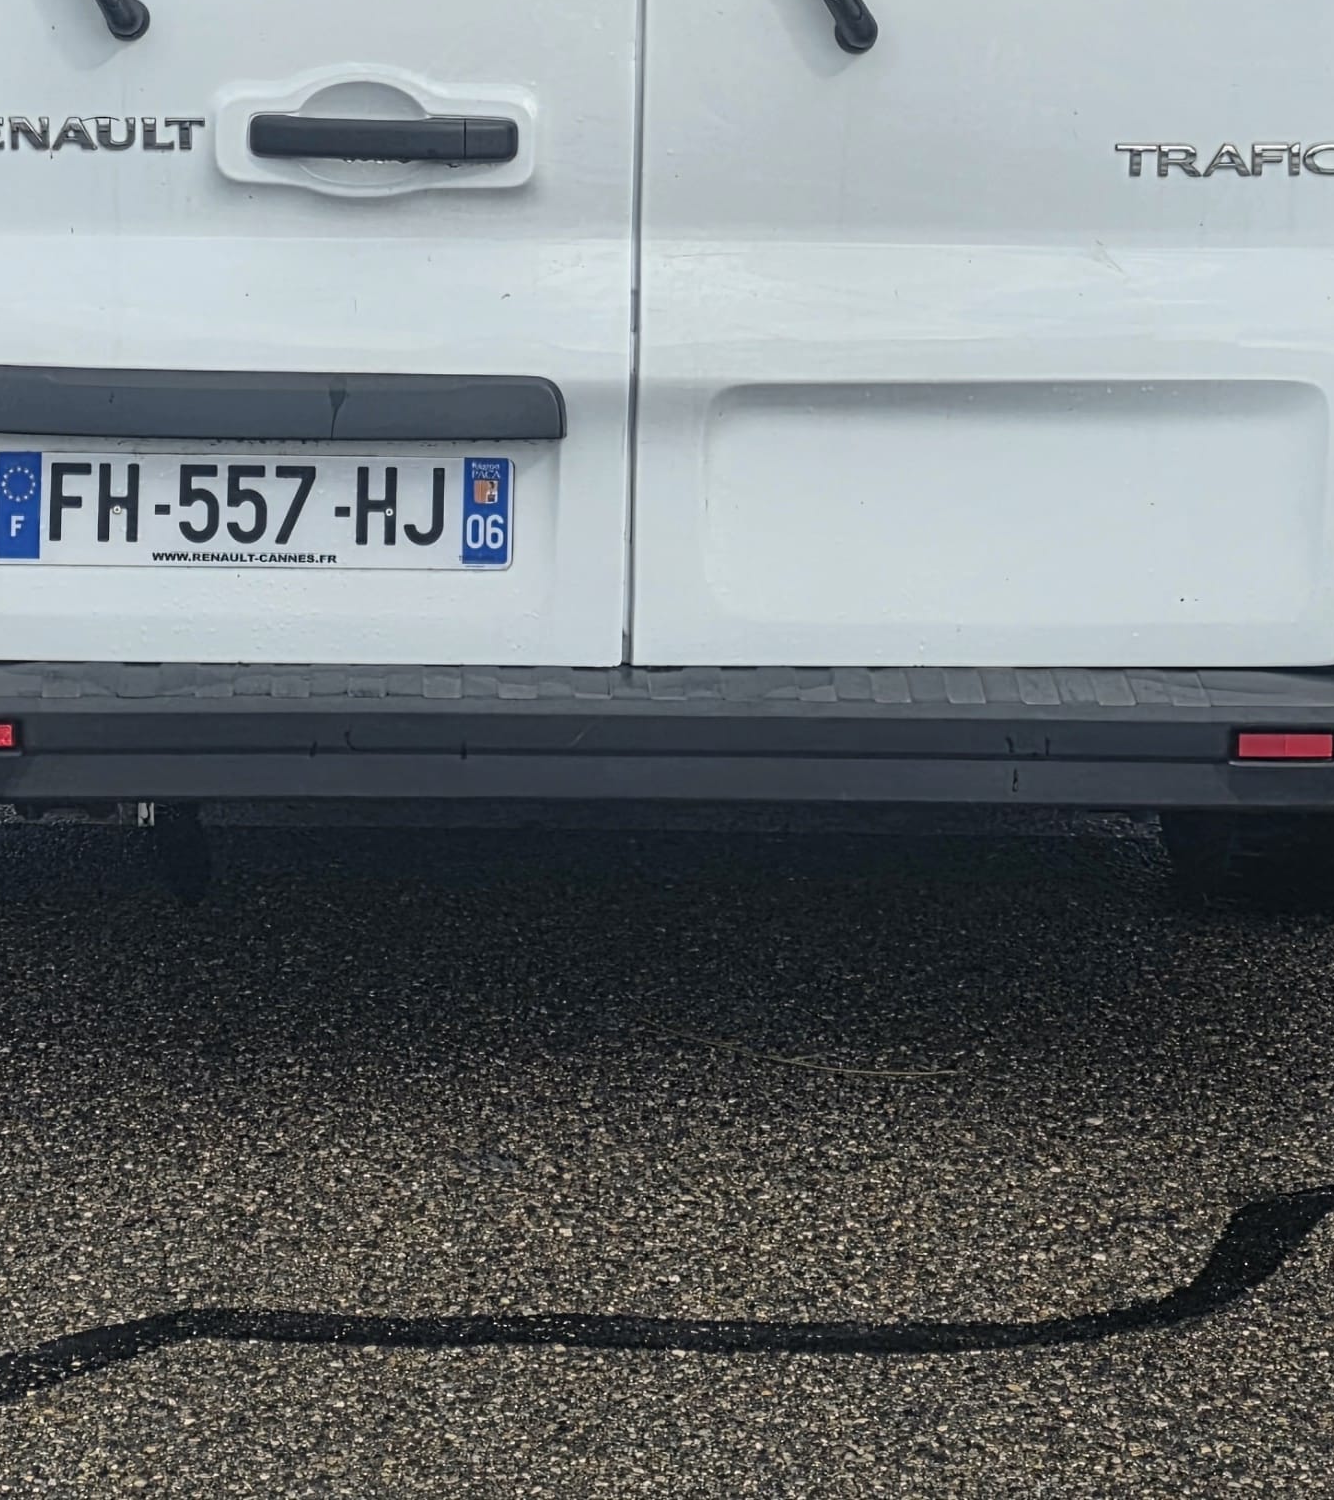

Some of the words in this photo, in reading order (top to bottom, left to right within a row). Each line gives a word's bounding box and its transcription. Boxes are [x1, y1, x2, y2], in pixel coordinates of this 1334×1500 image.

[48, 462, 446, 546] FH-557-HJ
[10, 515, 25, 537] F
[466, 514, 505, 549] 06
[152, 551, 337, 564] WWW.RENAULT-CANNES.FR
